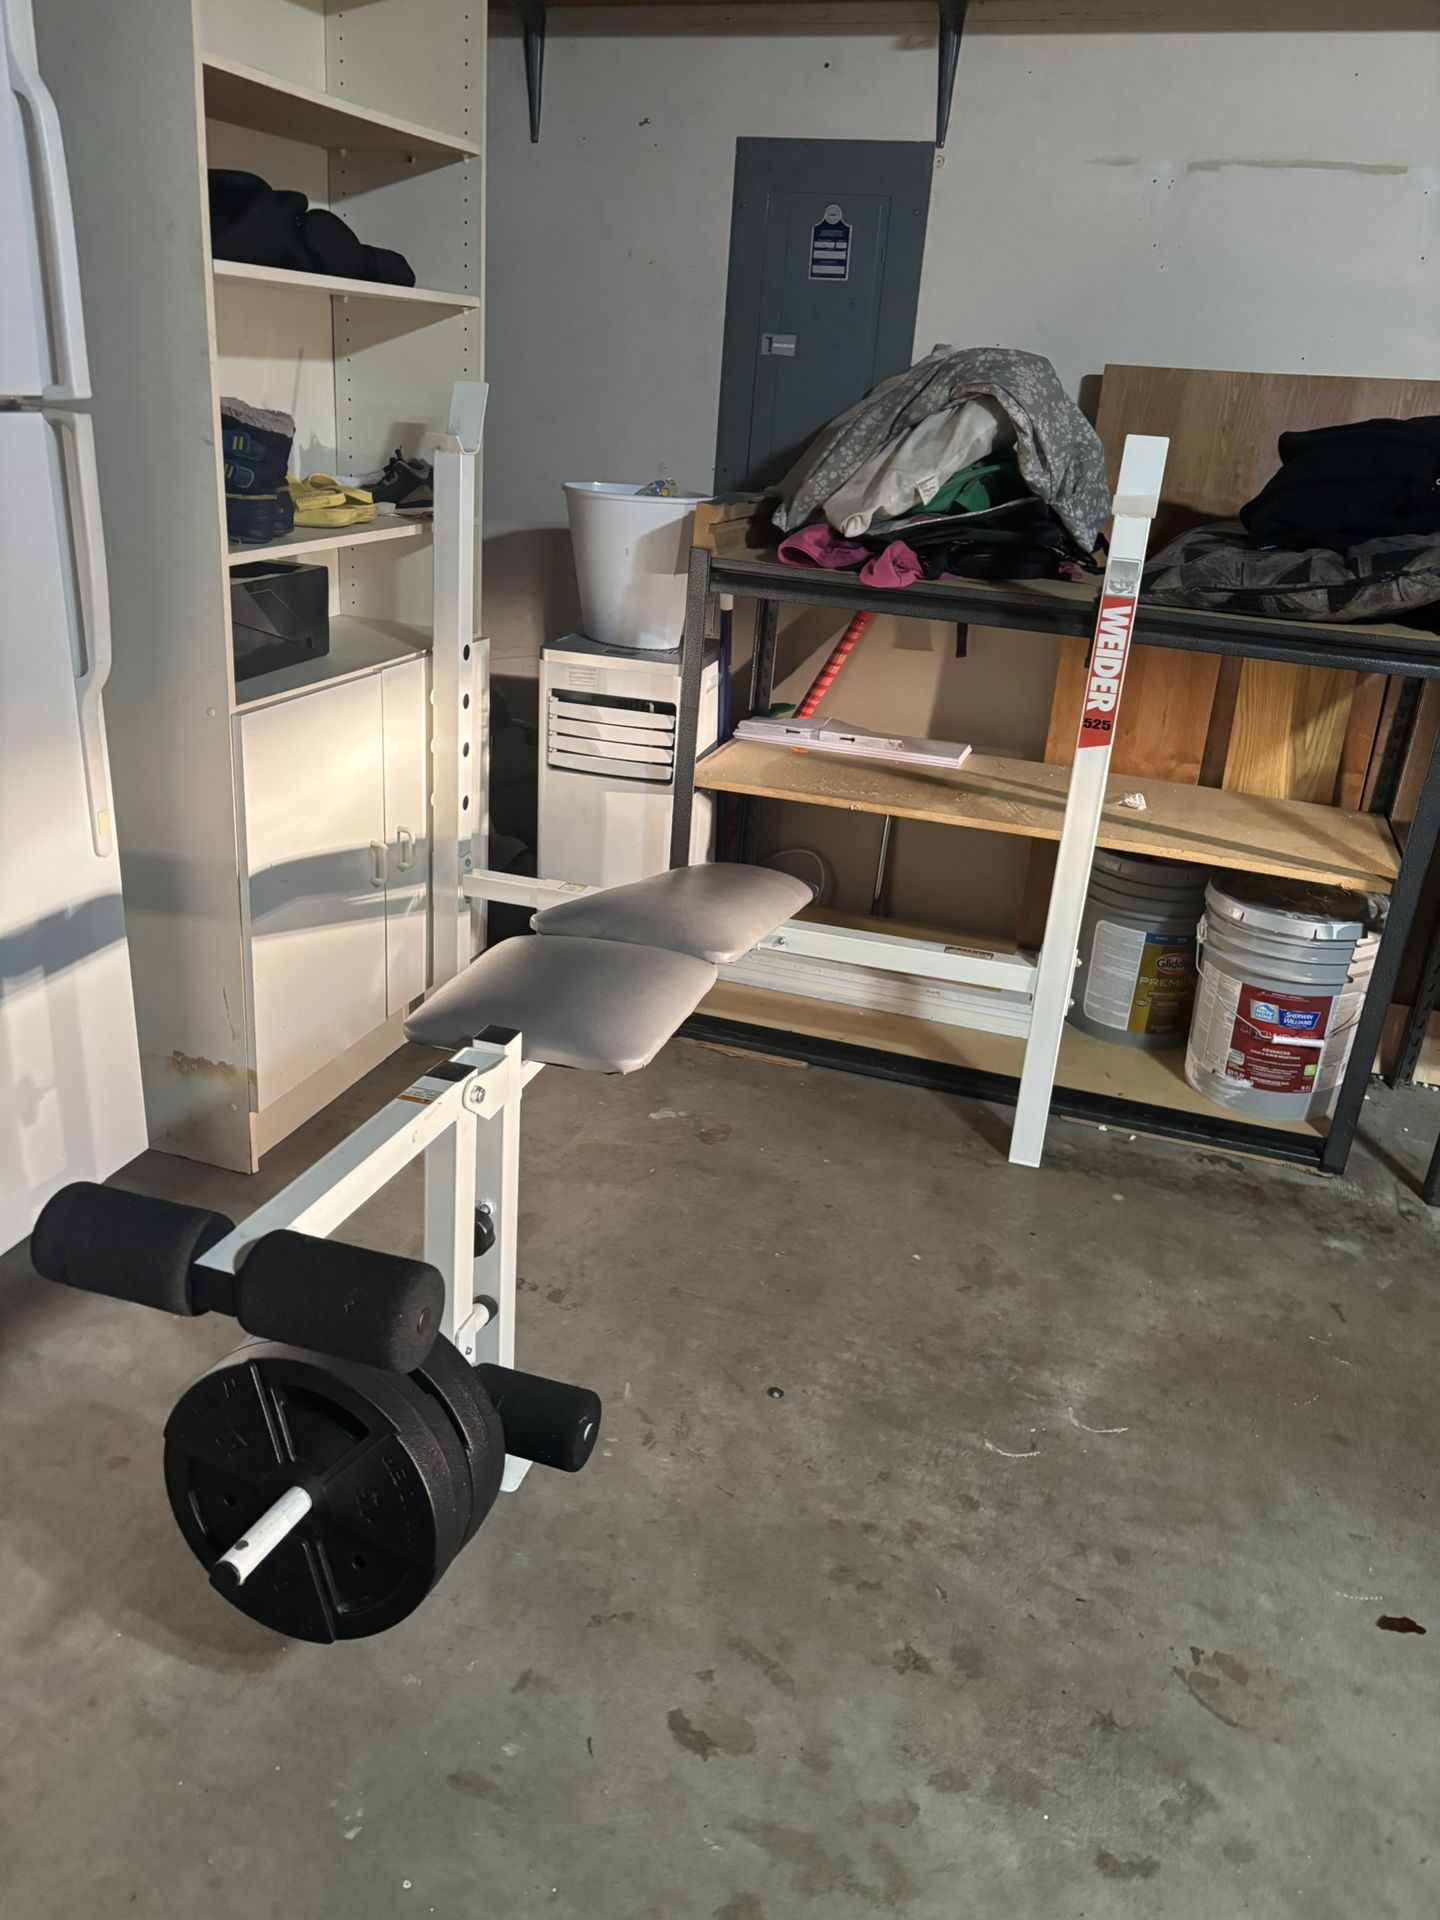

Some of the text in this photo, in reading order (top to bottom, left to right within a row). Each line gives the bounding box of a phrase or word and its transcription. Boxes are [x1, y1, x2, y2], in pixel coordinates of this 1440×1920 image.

[1086, 605, 1132, 713] WEIDER
[1083, 718, 1112, 731] 525
[1156, 958, 1188, 969] Glidd
[1139, 976, 1186, 988] PREMI
[1286, 1011, 1314, 1020] SHERWIN
[1283, 1017, 1312, 1026] WILLIAMS
